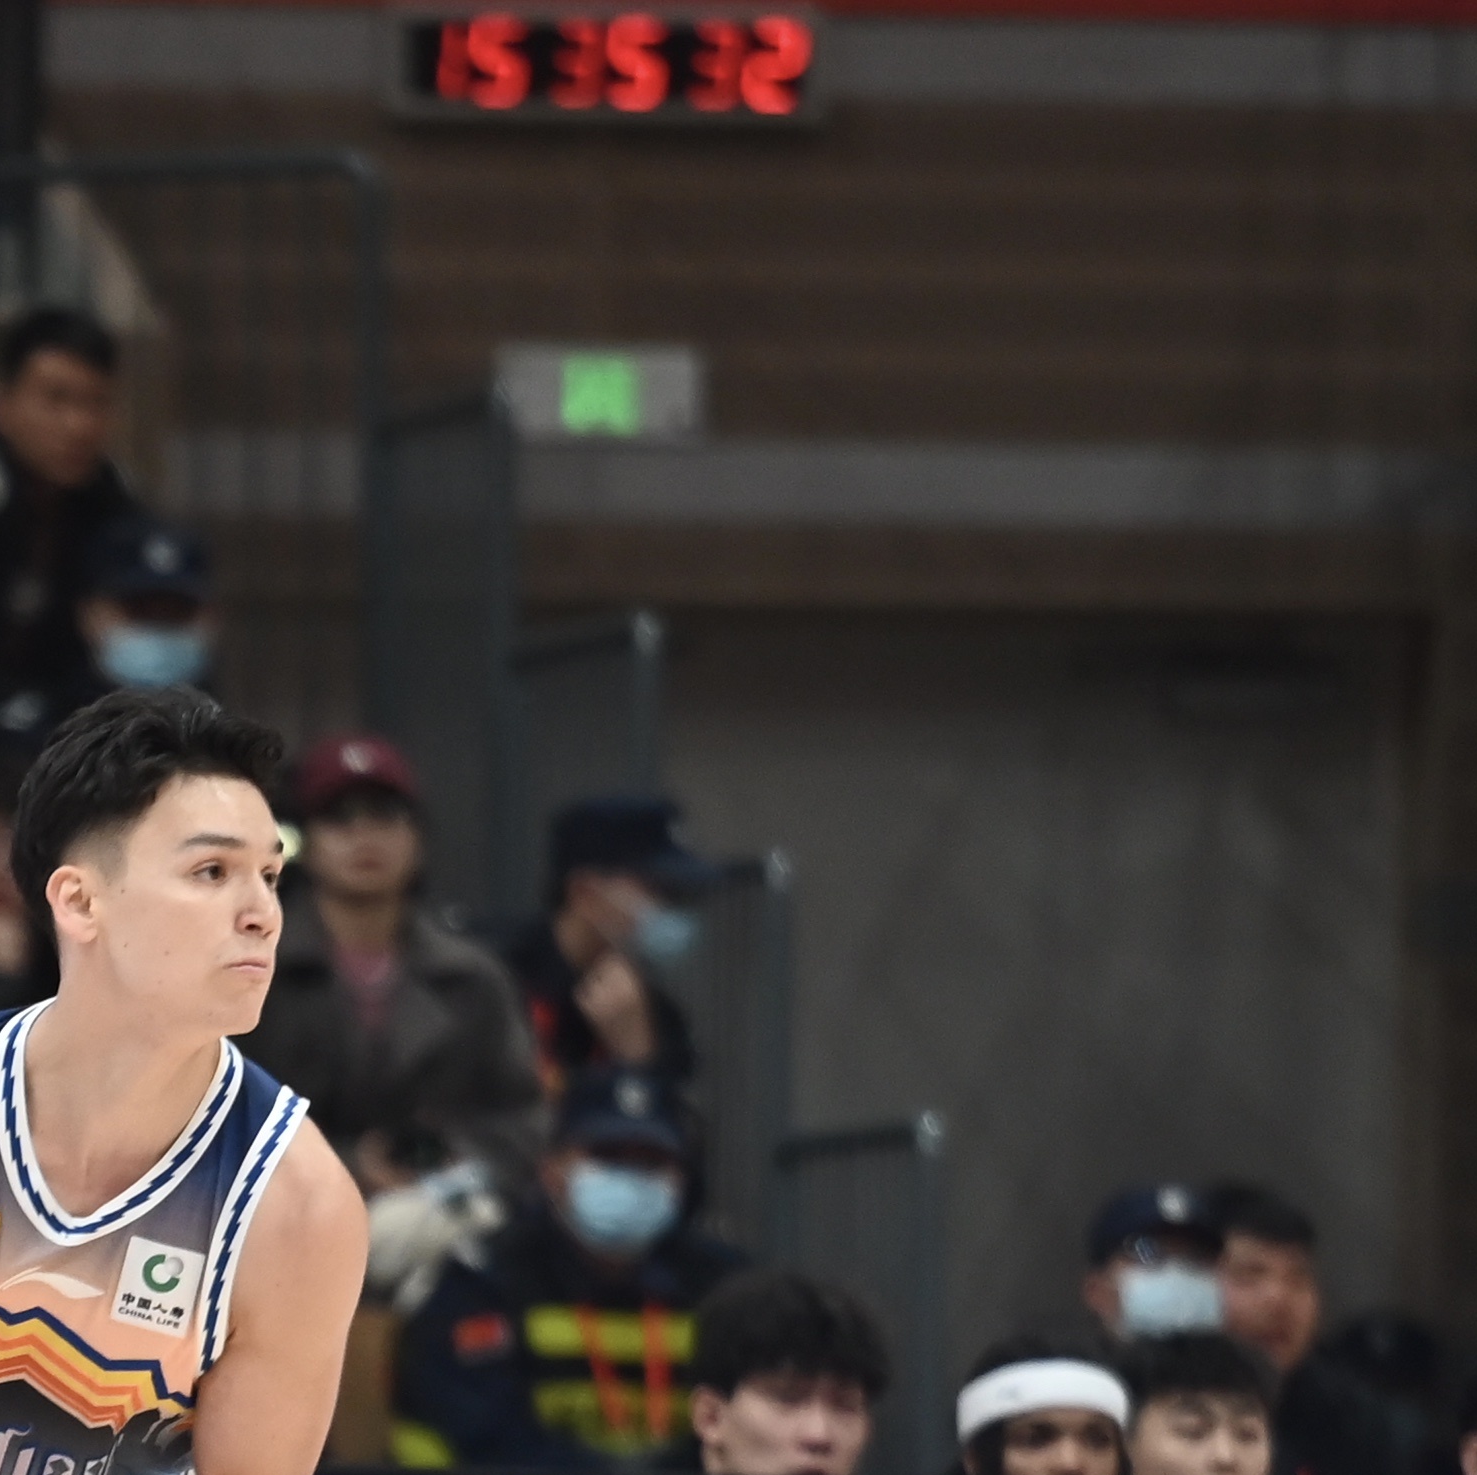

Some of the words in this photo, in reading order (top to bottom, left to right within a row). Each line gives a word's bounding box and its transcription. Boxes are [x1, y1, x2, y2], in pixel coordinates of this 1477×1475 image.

[437, 12, 533, 111] 15
[549, 13, 670, 113] 35
[688, 15, 814, 115] 32
[118, 1307, 153, 1322] CHINA
[156, 1317, 181, 1329] LIFE
